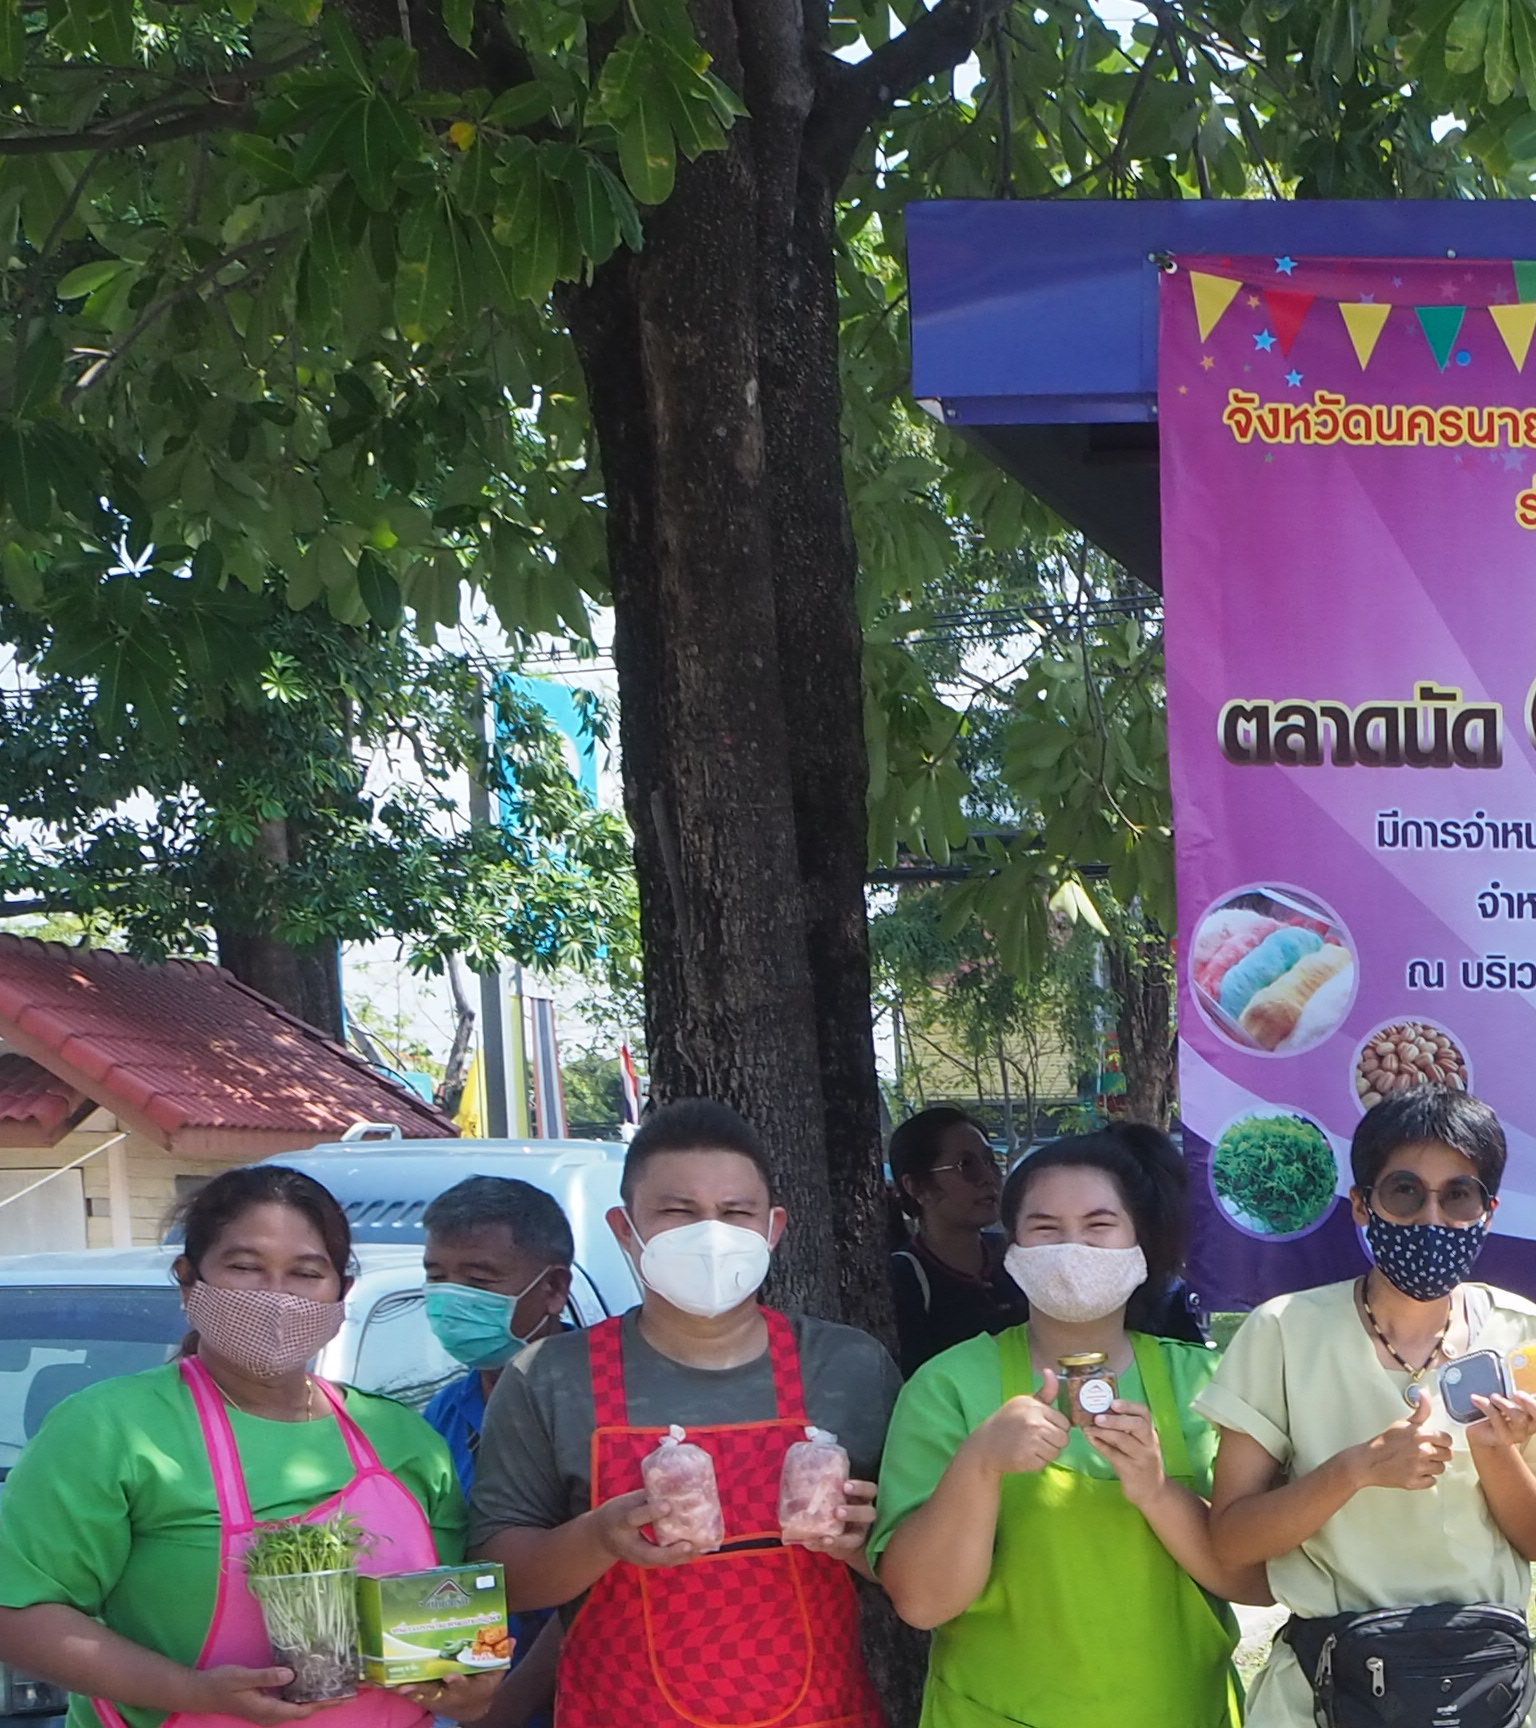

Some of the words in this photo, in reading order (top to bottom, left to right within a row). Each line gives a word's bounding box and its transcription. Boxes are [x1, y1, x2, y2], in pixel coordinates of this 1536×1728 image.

[1219, 682, 1504, 770] ตลาดนัด
[1408, 959, 1445, 990] ณ
